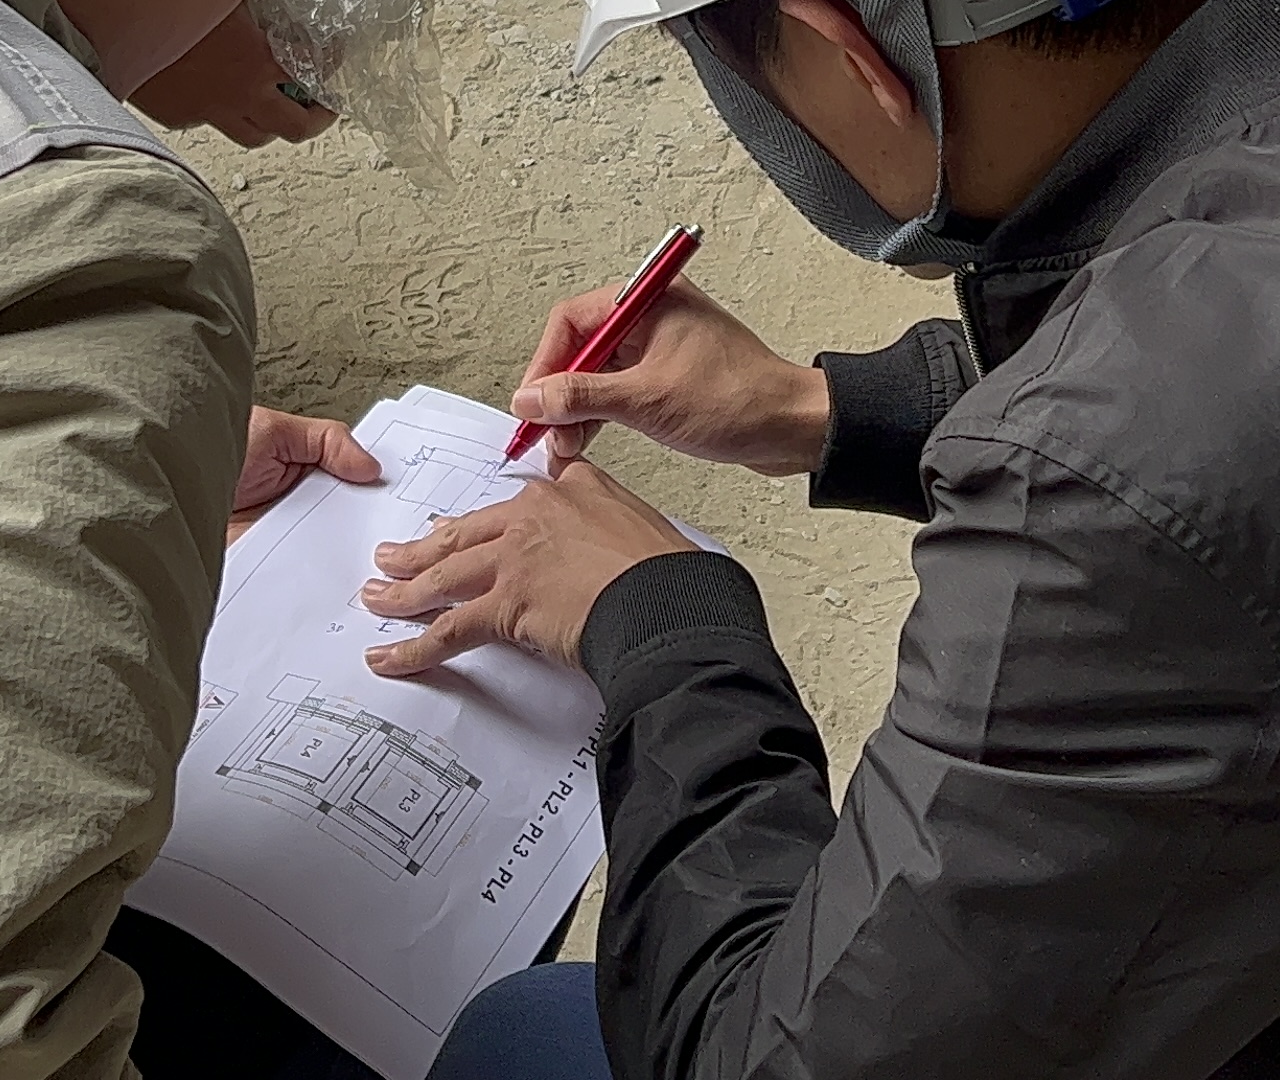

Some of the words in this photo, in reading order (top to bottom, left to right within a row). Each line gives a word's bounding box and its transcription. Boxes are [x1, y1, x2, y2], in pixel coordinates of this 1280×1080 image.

[300, 738, 323, 759] PL4
[398, 788, 422, 814] PL3
[542, 779, 574, 815] PL2
[512, 822, 544, 858] PL3
[481, 867, 515, 905] PL4
